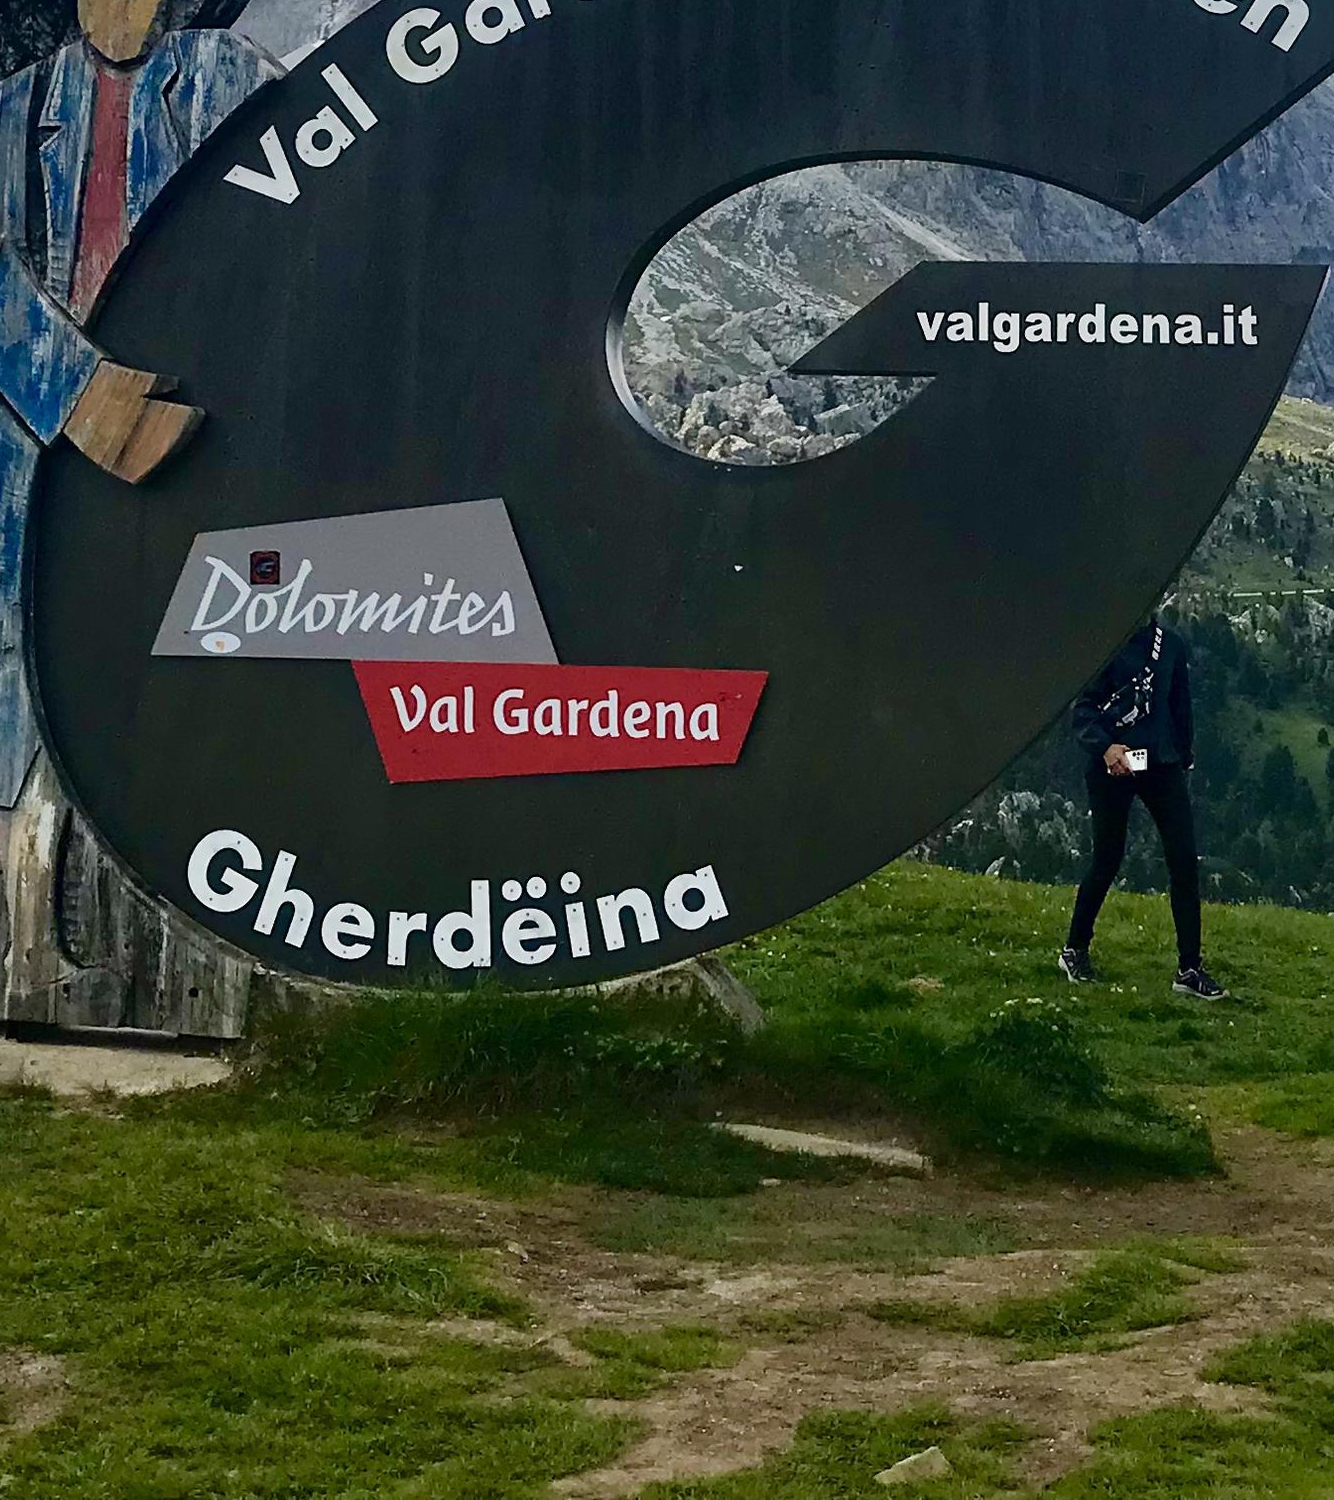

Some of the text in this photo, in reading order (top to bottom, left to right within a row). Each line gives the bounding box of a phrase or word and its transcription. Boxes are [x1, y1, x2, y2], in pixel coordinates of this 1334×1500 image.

[223, 62, 379, 205] Val
[916, 302, 1259, 353] valgardena.it
[190, 555, 516, 637] Dolomites
[389, 684, 720, 741] Val Gardena
[187, 829, 729, 969] Gherdëina
